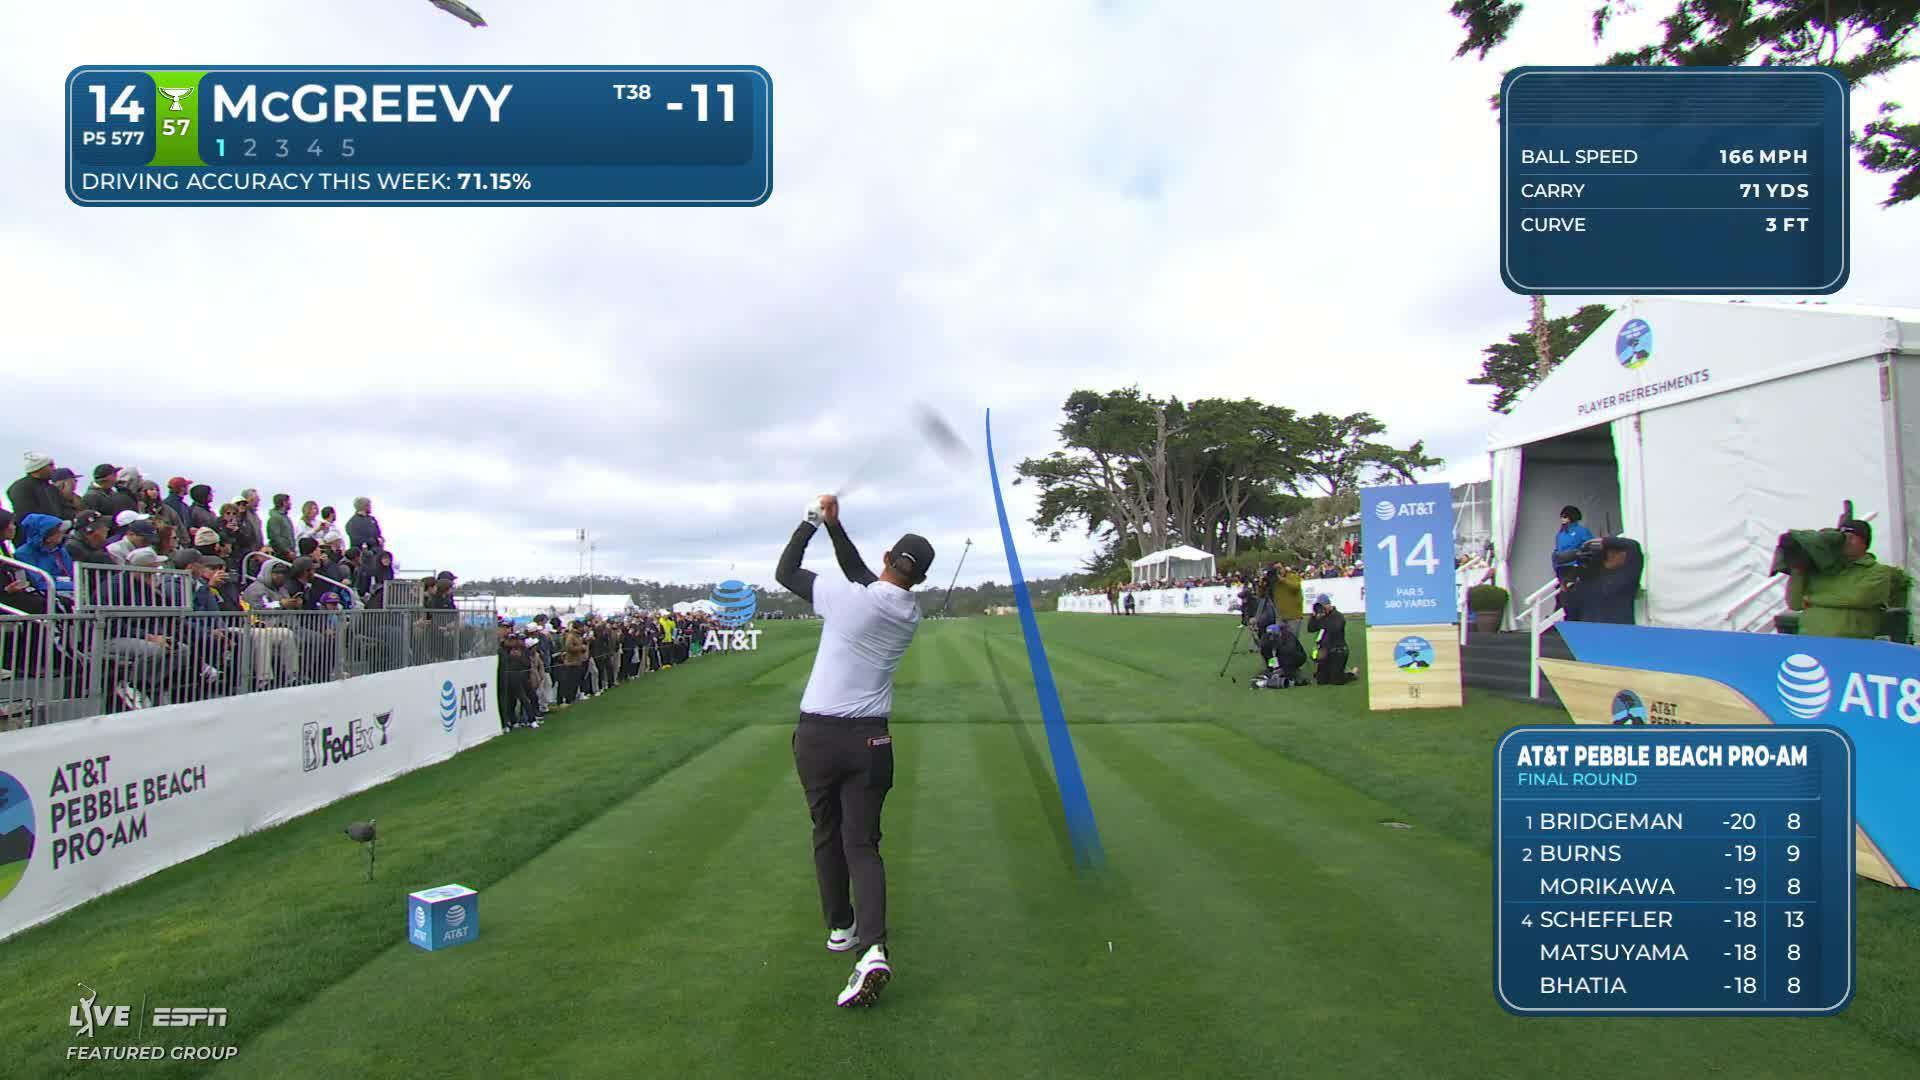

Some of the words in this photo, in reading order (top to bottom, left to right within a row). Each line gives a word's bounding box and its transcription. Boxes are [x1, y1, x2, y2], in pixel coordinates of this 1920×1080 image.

[1577, 396, 1617, 416] PLAYER
[1618, 368, 1710, 405] REFRESHMENTS
[1398, 501, 1435, 517] AT&T
[1378, 533, 1439, 576] 14
[459, 683, 487, 718] AT&T
[322, 718, 374, 767] FedEx
[50, 755, 111, 797] AT&T
[51, 782, 139, 834] PEBBLE
[143, 764, 207, 806] BEACH
[52, 811, 148, 870] PRO-AM
[443, 927, 468, 942] AT&T
